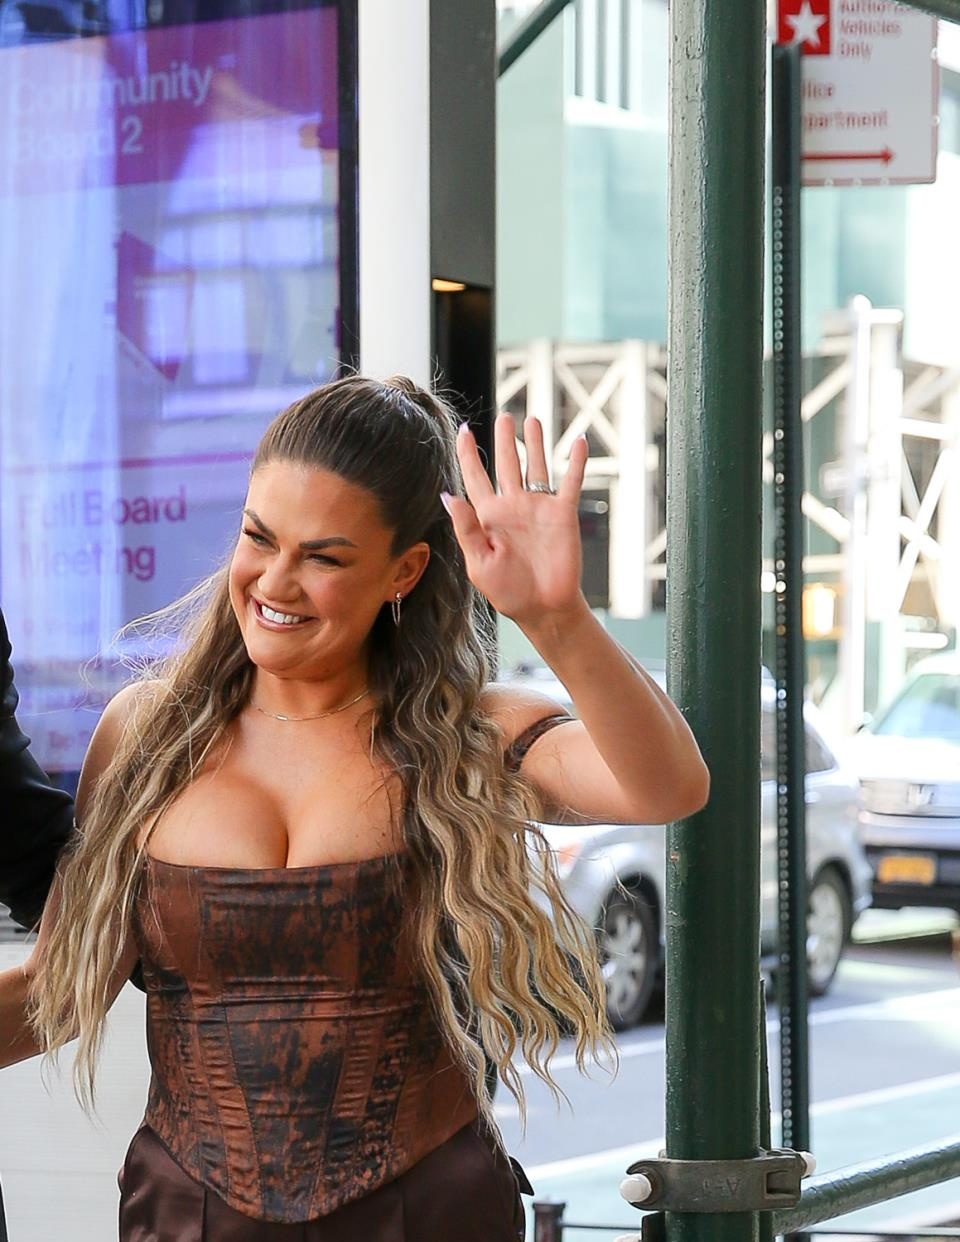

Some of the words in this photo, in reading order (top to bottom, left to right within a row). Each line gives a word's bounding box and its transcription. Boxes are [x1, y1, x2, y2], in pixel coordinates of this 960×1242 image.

[840, 17, 903, 37] Vehicles
[840, 42, 872, 60] Only
[802, 81, 836, 99] lice
[802, 110, 889, 134] partment
[121, 114, 144, 155] 2
[84, 484, 188, 526] Board
[18, 541, 157, 583] Meetng
